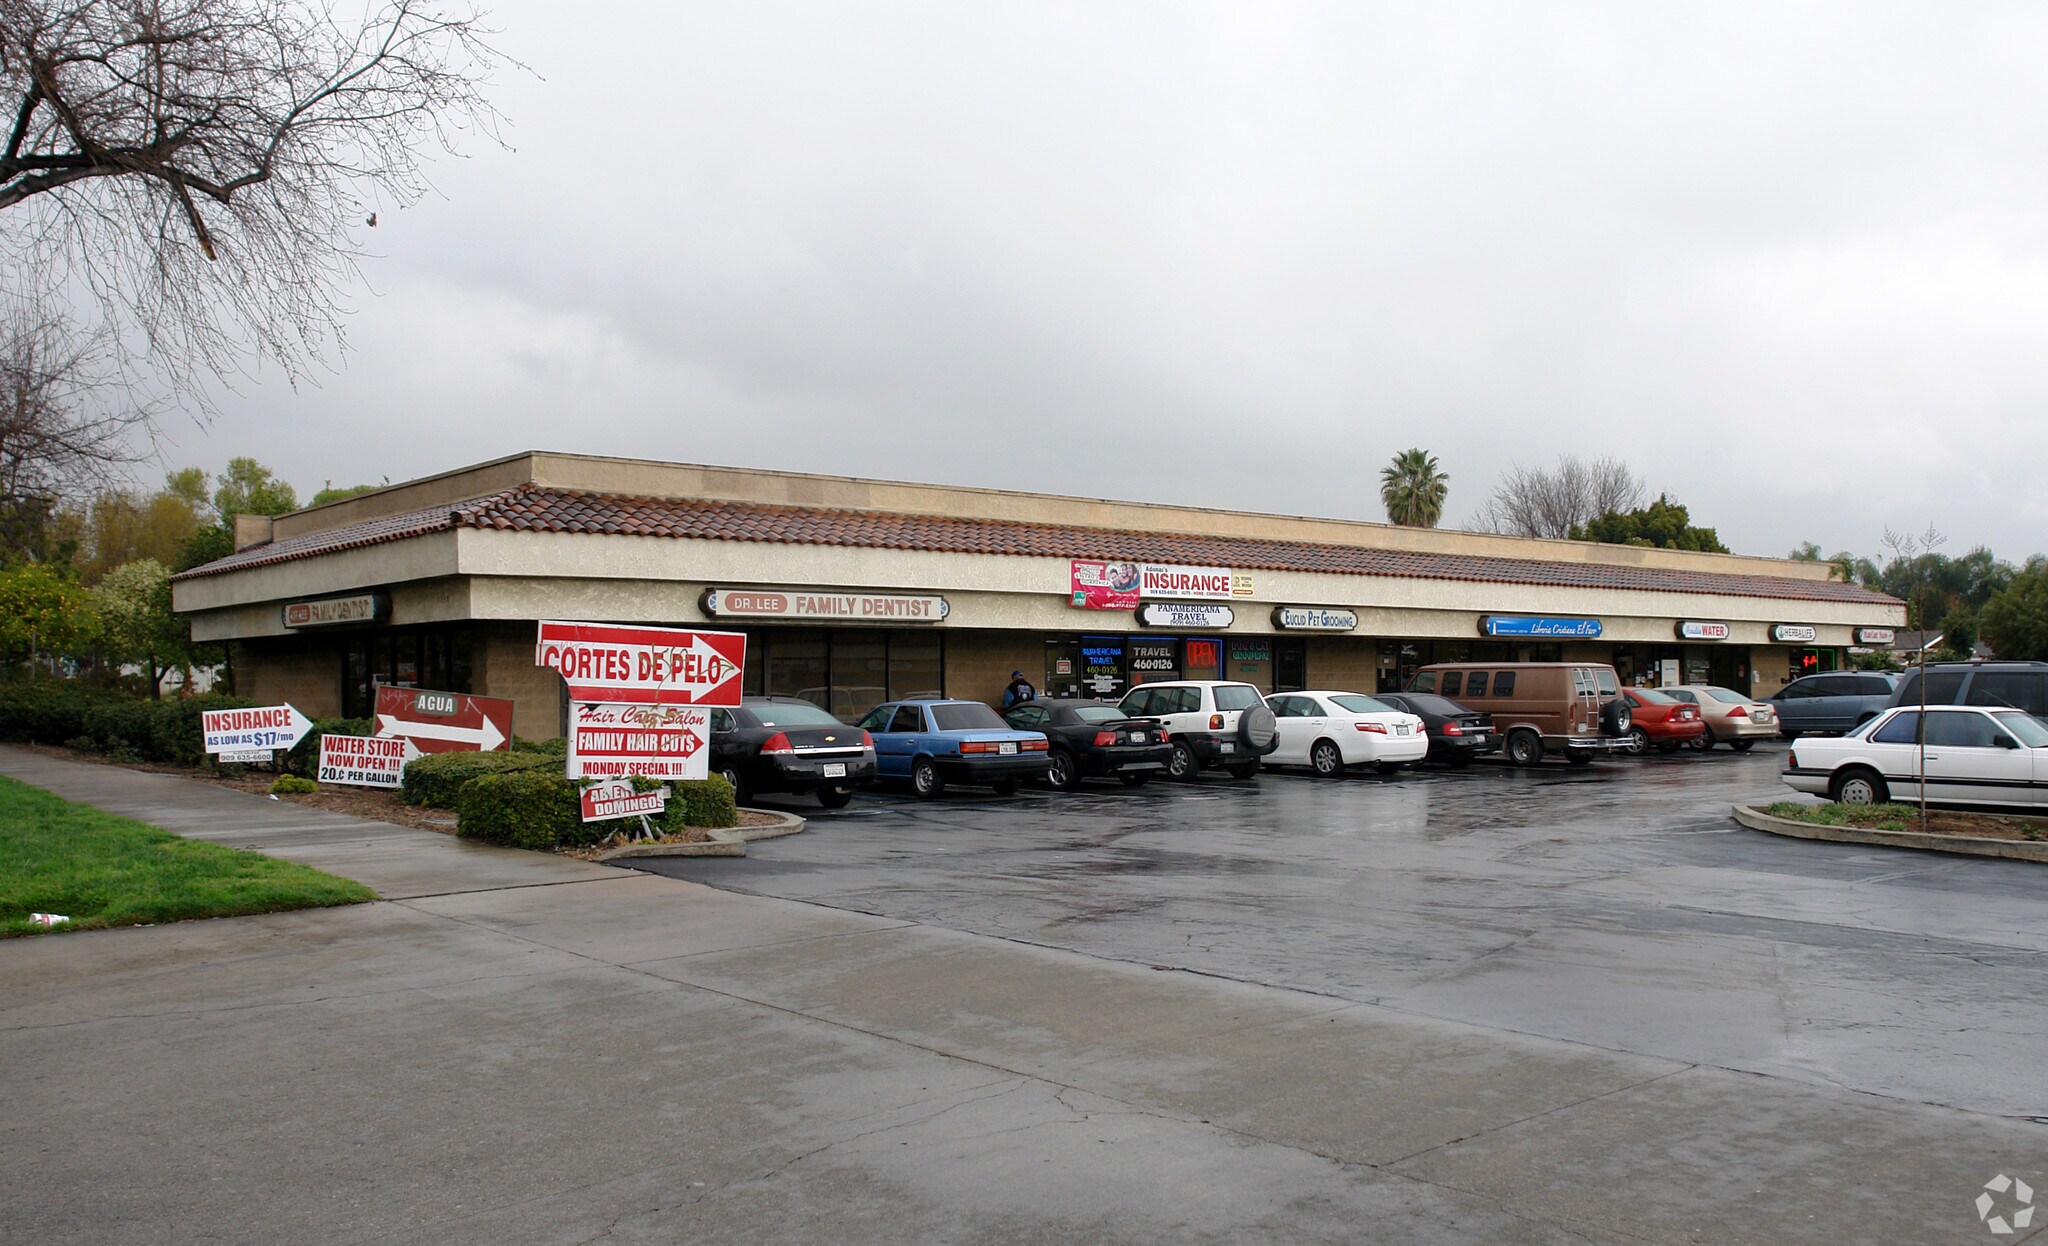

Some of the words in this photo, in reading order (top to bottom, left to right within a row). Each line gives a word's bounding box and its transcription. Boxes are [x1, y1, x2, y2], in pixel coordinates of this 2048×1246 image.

[1144, 572, 1230, 592] INSURANCE
[734, 598, 754, 609] DR.
[756, 598, 779, 610] LEE
[796, 596, 857, 615] FAMILY
[862, 598, 932, 617] DENTIST
[1157, 604, 1220, 614] PANAMERICANA
[1171, 612, 1207, 621] TRAVEL
[1701, 625, 1724, 636] WATER
[1785, 628, 1812, 638] HERBALIFE
[1133, 647, 1171, 657] TRAVEL
[1187, 641, 1217, 667] OPEN
[544, 645, 630, 681] CORTES
[638, 652, 663, 681] DE
[671, 653, 721, 684] PELO
[1089, 657, 1114, 665] TRAVEL
[418, 695, 453, 712] AGUA
[205, 709, 292, 732] INSURANCE
[578, 704, 616, 723] Hair
[207, 736, 219, 746] AS
[220, 735, 240, 745] LOW
[241, 734, 253, 744] AS
[254, 731, 294, 747] $17/mo
[324, 736, 365, 753] WATER
[368, 740, 406, 758] STORE
[578, 732, 625, 751] FAMILY
[626, 732, 659, 752] HAIR
[660, 733, 695, 752] CUTS
[327, 754, 354, 768] NOW
[357, 756, 385, 770] OPEN
[389, 759, 400, 772] !!!
[583, 762, 626, 775] MONDAY
[629, 762, 669, 775] SPECIAL
[672, 762, 683, 775] !!!
[348, 771, 363, 782] PER
[366, 772, 397, 784] GALLON
[594, 795, 665, 816] DOMINGOS
